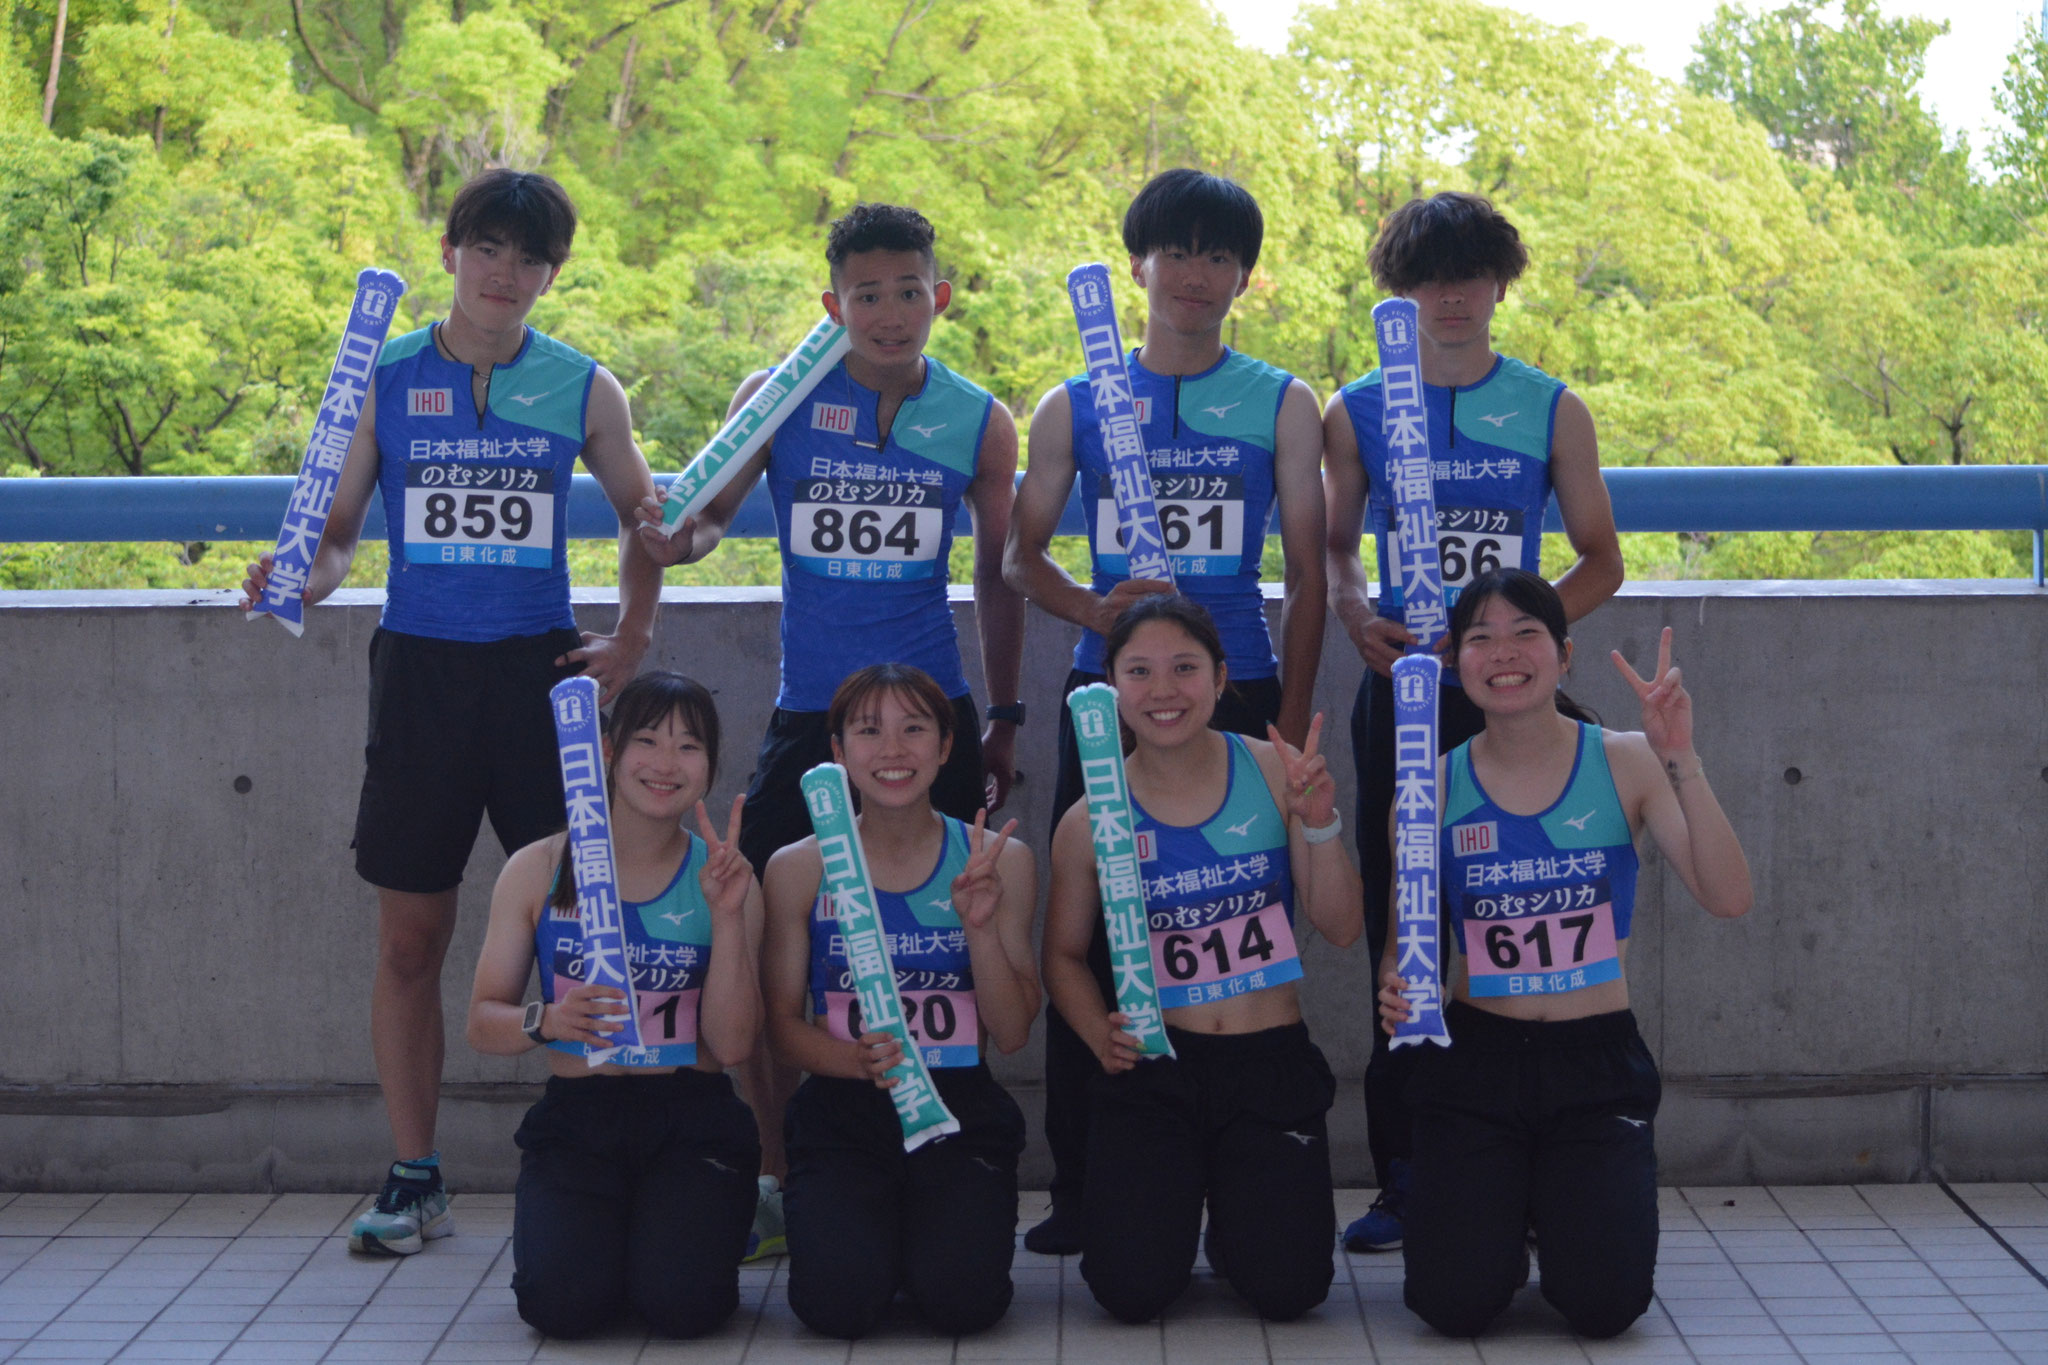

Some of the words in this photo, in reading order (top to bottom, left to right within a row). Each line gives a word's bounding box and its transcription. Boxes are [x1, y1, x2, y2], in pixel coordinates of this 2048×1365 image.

[410, 437, 550, 460] 日本福祉大学
[1144, 446, 1239, 468] 福祉大学
[267, 331, 381, 607] 日本福祉大学
[421, 464, 538, 490] のむシリカ
[810, 457, 943, 486] 日本福祉大学
[1385, 458, 1521, 481] 福祉大学
[809, 480, 926, 505] のむシリカ
[1150, 477, 1228, 499] シリカ
[1382, 364, 1447, 645] 日本福祉大学
[424, 493, 533, 540] 859
[811, 508, 920, 556] 864
[1116, 504, 1223, 550] 61
[1436, 510, 1509, 532] シリカ
[441, 545, 517, 564] 日東化成
[827, 560, 903, 579] 日東化成
[1170, 557, 1208, 575] 化成
[1438, 536, 1502, 582] 66
[1396, 724, 1438, 1024] 日本福祉大学
[1466, 850, 1607, 888] 日本福祉大学
[1151, 890, 1266, 930] のむシリカ
[1474, 884, 1596, 918] のむシリカ
[1163, 916, 1274, 980] 614
[1485, 913, 1594, 969] 617
[818, 833, 932, 1124] 日本福祉学
[839, 971, 960, 989] のシリカ
[1187, 971, 1267, 1004] 日東化成
[1509, 969, 1586, 993] 日東化成
